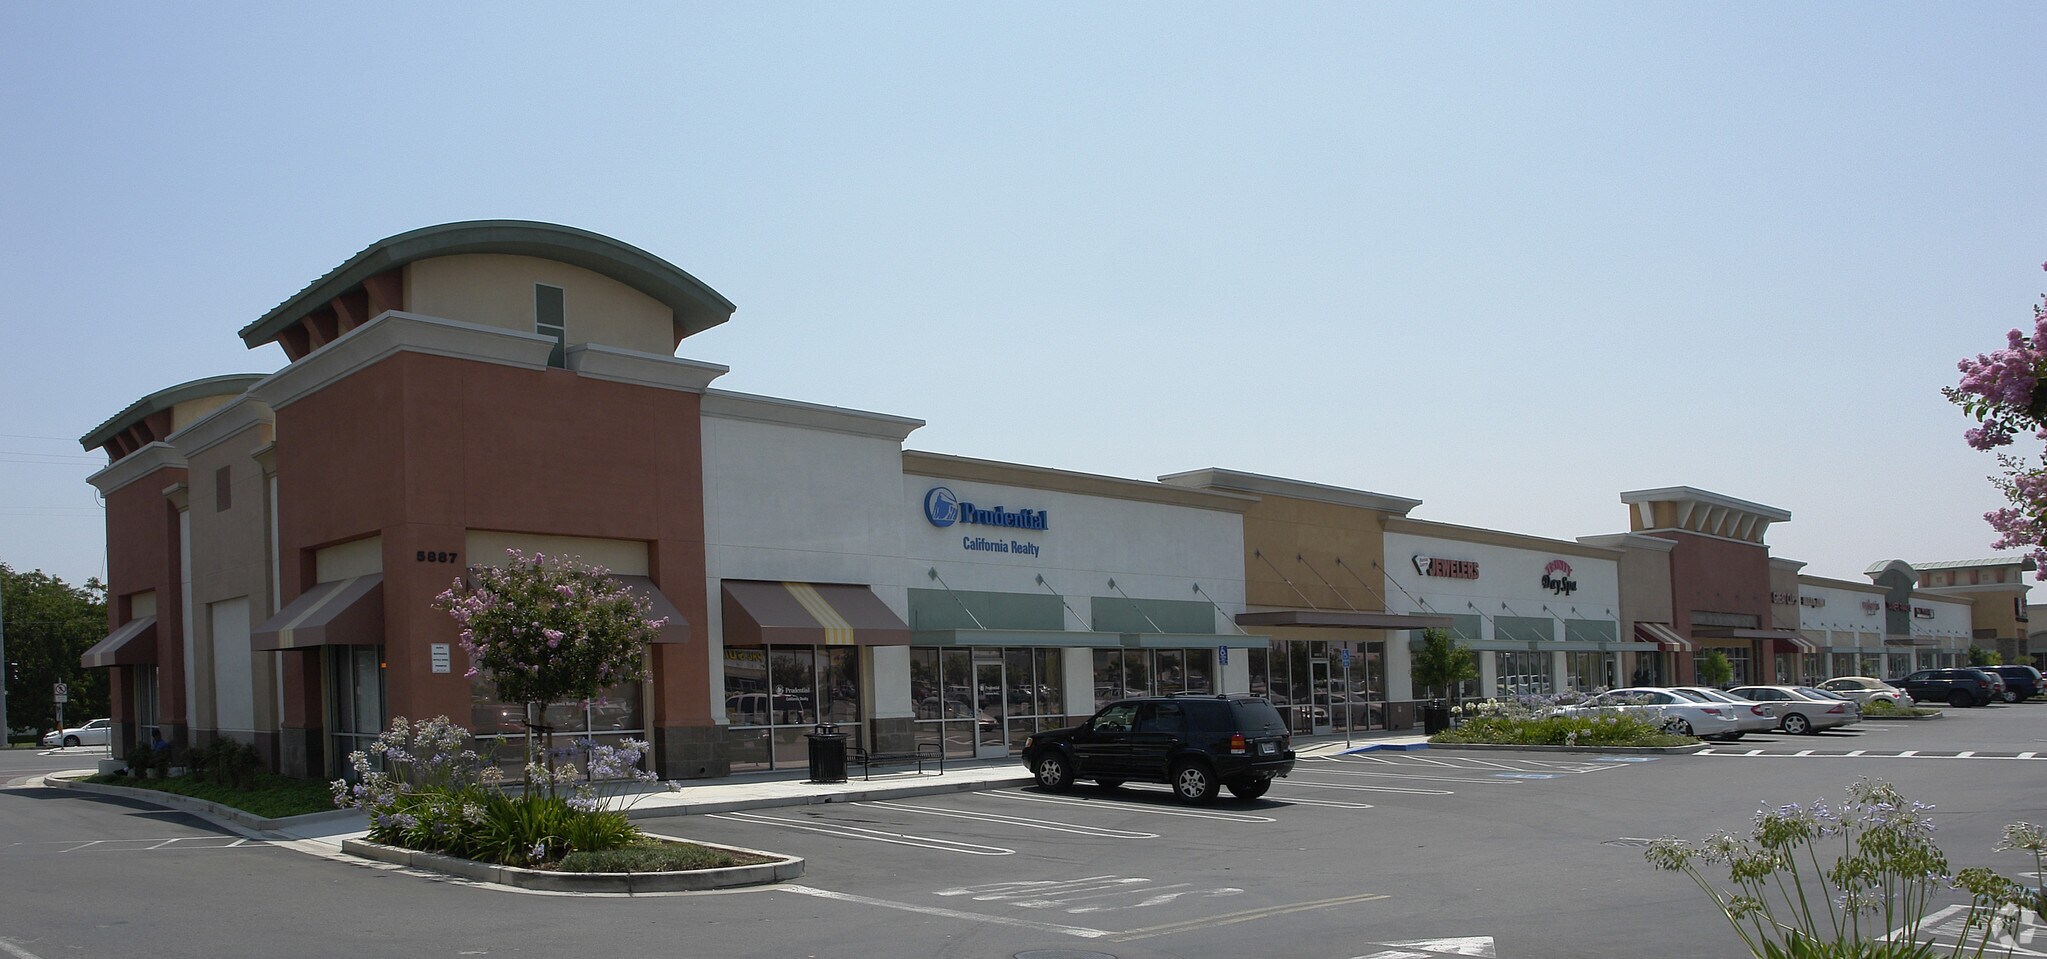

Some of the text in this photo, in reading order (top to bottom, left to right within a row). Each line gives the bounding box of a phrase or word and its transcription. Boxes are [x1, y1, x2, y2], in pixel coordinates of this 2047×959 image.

[959, 502, 1049, 531] Prudential
[417, 551, 458, 563] 5887
[963, 537, 1040, 558] California Realty
[1430, 558, 1479, 579] JEWELERS
[1541, 575, 1577, 596] Day Spa
